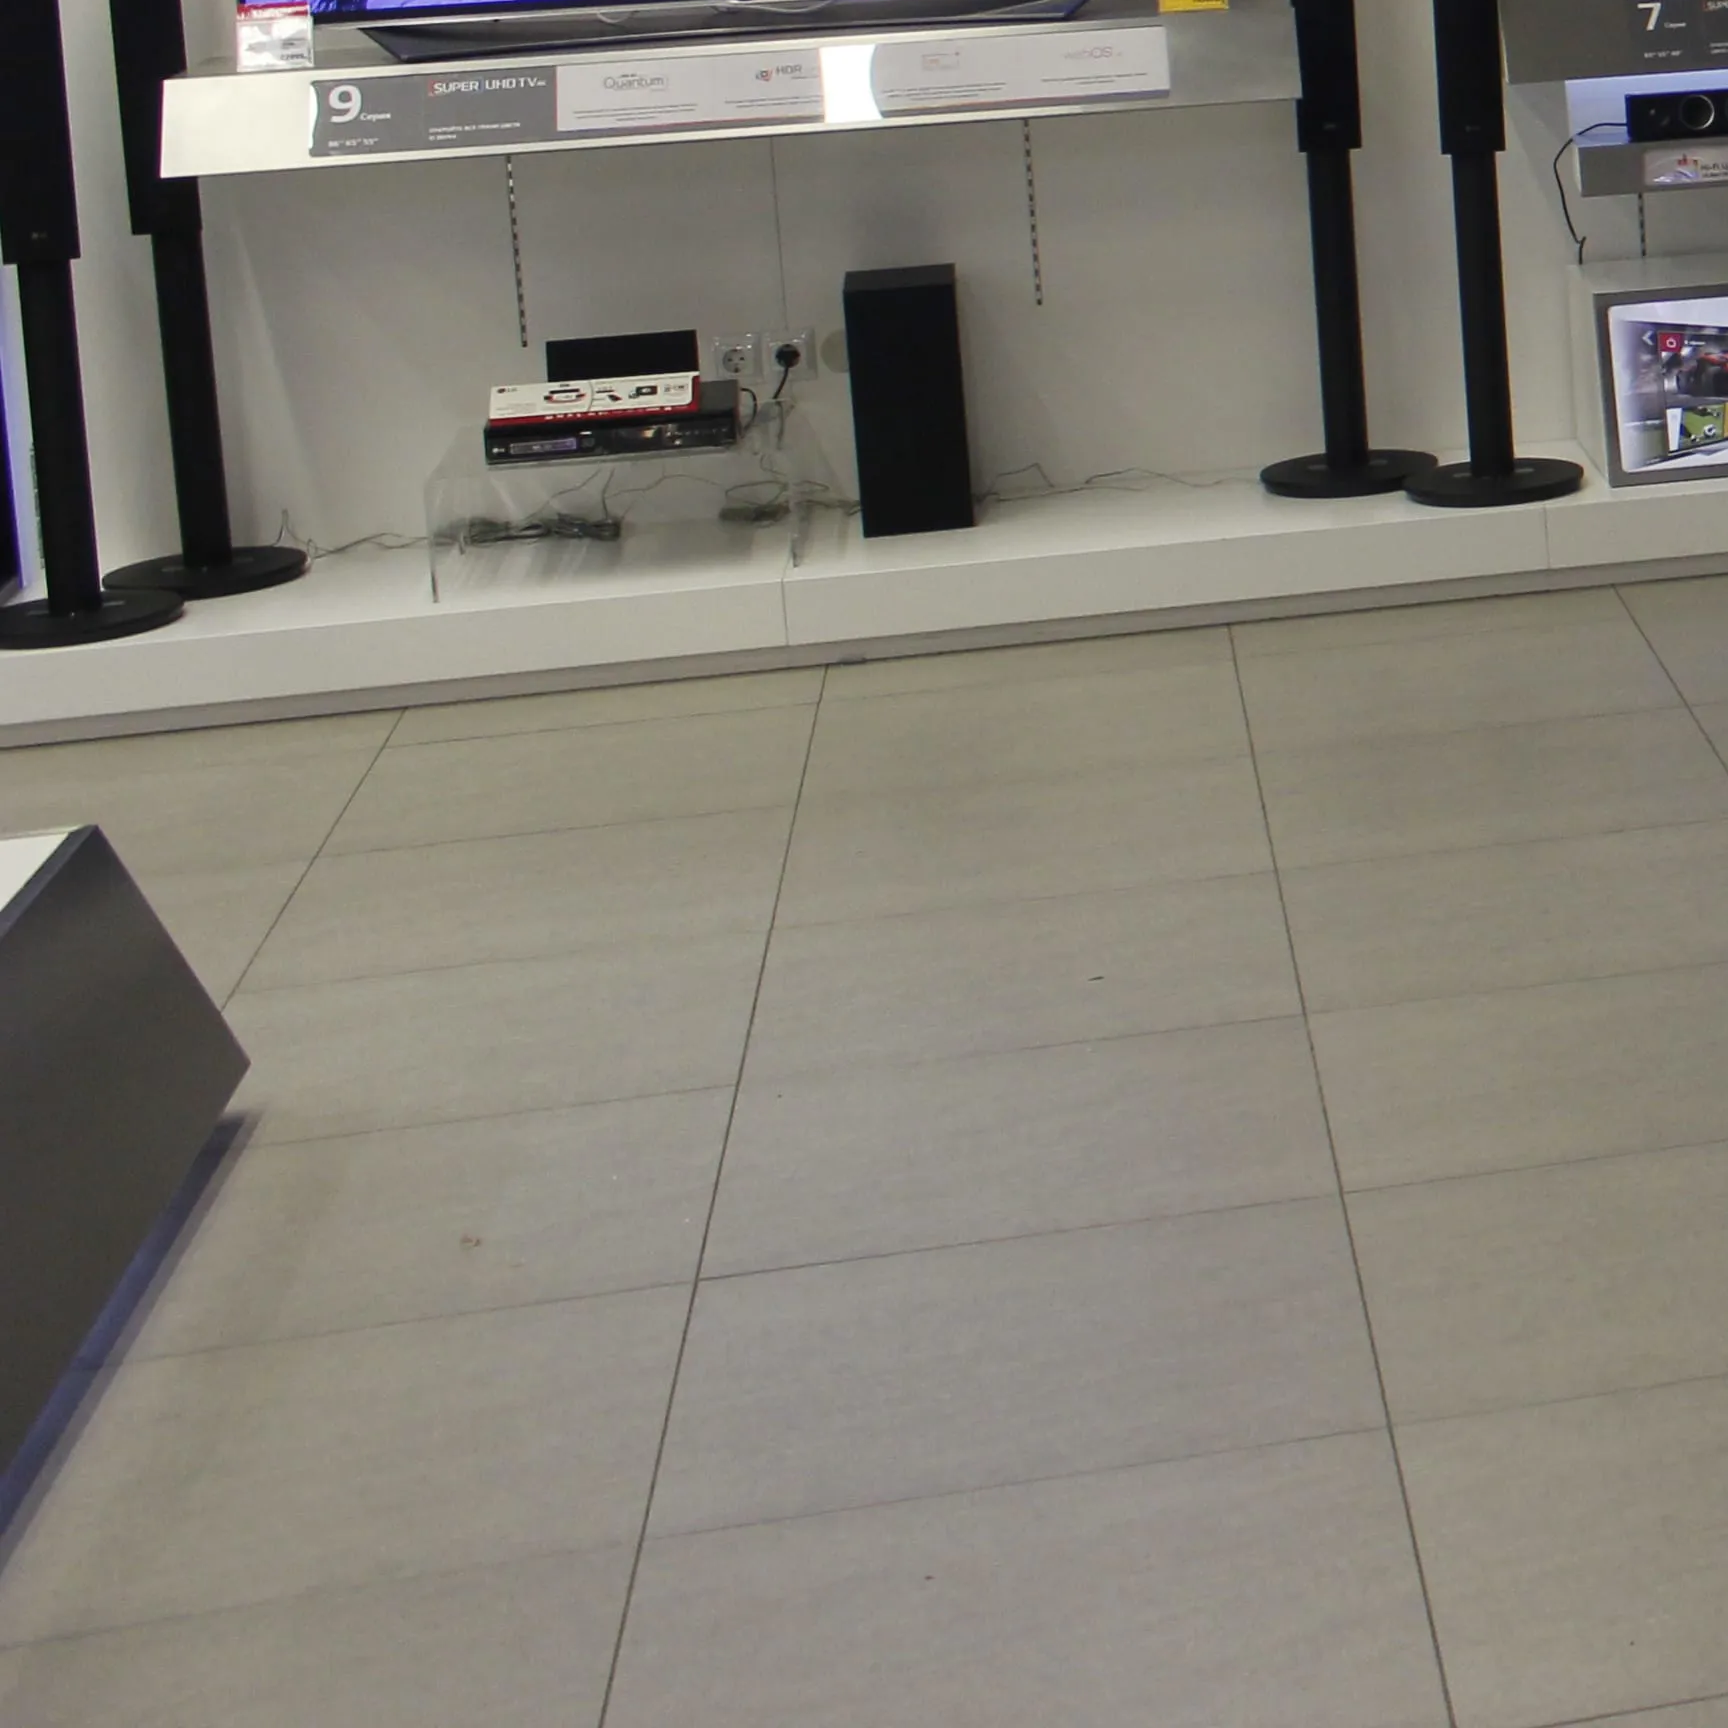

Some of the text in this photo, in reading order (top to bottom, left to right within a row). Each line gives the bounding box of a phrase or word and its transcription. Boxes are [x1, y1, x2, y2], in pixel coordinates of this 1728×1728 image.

[1636, 2, 1662, 32] 7
[432, 80, 480, 95] SUPER
[485, 78, 517, 90] UHD
[327, 83, 362, 124] 9
